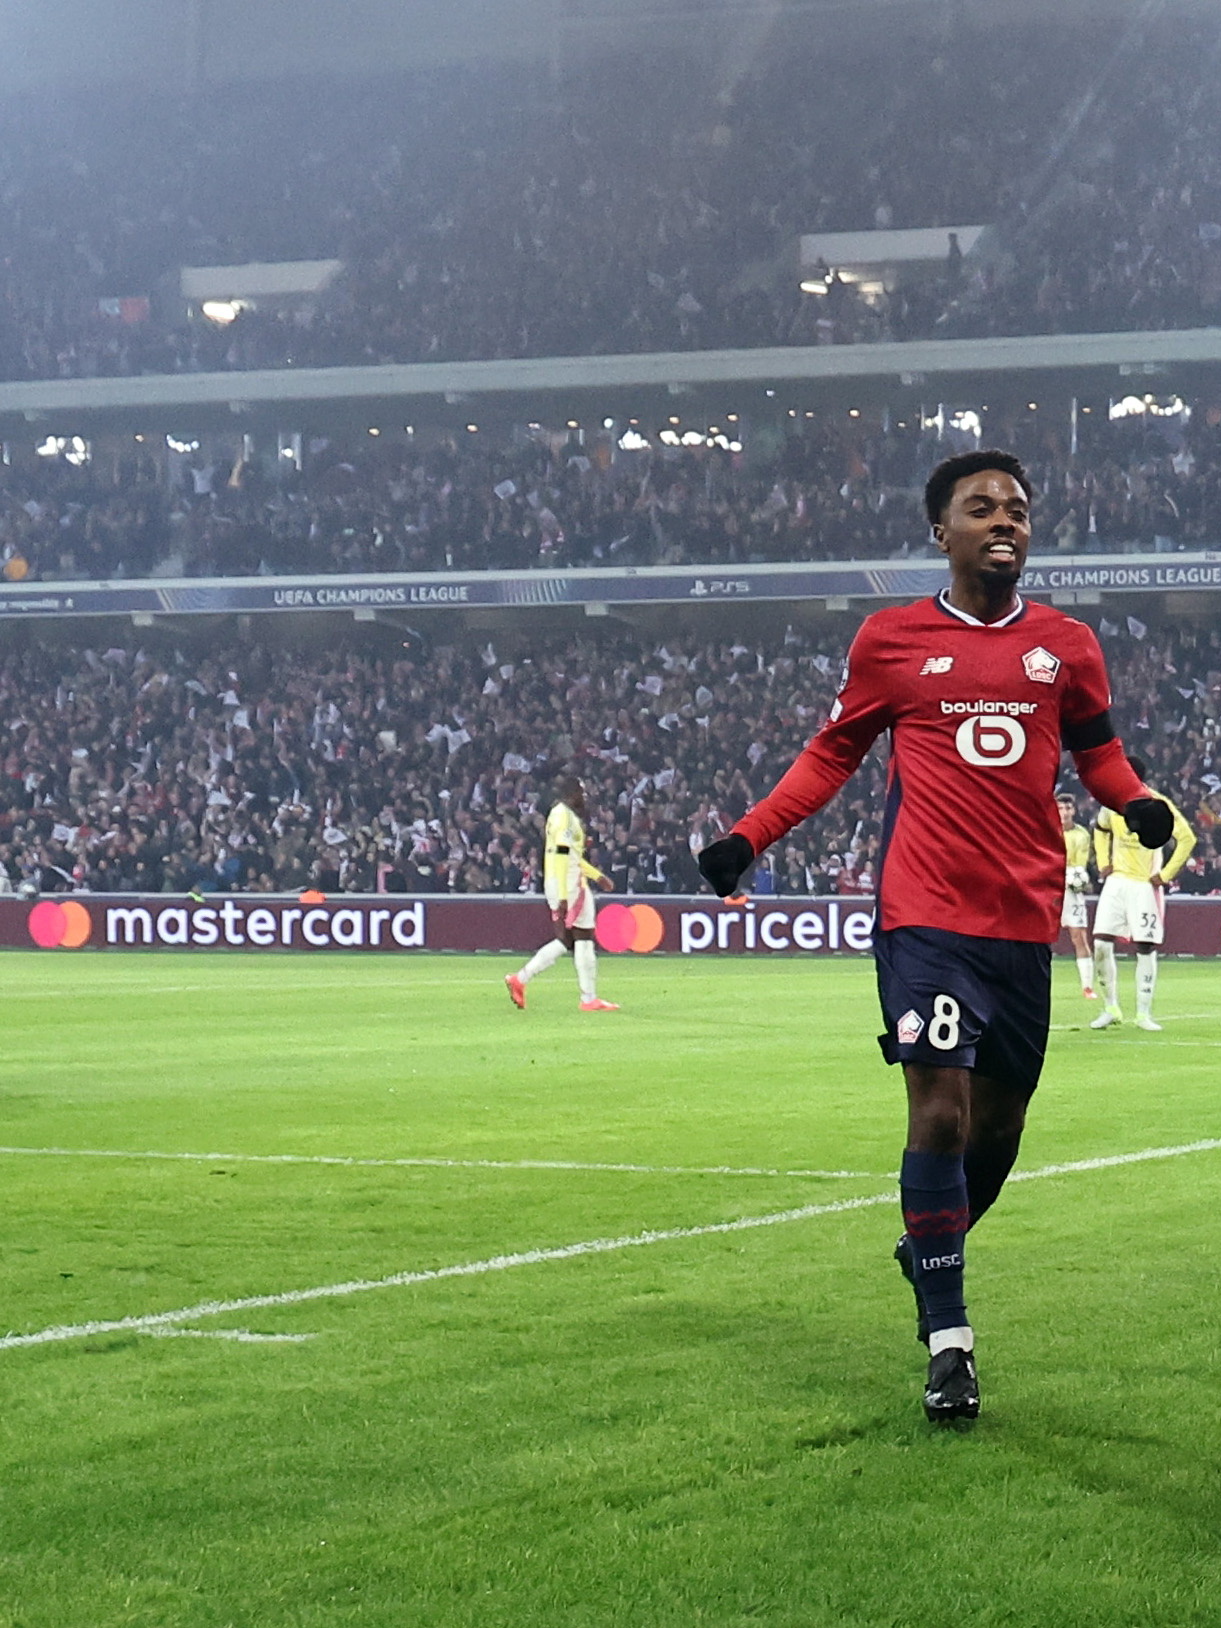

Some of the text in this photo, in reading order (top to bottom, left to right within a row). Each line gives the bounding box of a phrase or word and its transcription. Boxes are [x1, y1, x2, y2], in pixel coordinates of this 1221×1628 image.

[1050, 569, 1150, 586] CHAMPIONS
[1156, 567, 1221, 583] LEAGUE
[274, 586, 468, 605] UEFA CHAMPIONS LEAGUE
[710, 580, 750, 593] PS5
[940, 699, 1038, 716] boulanger
[106, 900, 426, 946] mastercard
[680, 902, 873, 954] pricele
[1140, 912, 1157, 929] 32
[928, 993, 961, 1051] 8
[922, 1253, 961, 1270] LOSC
